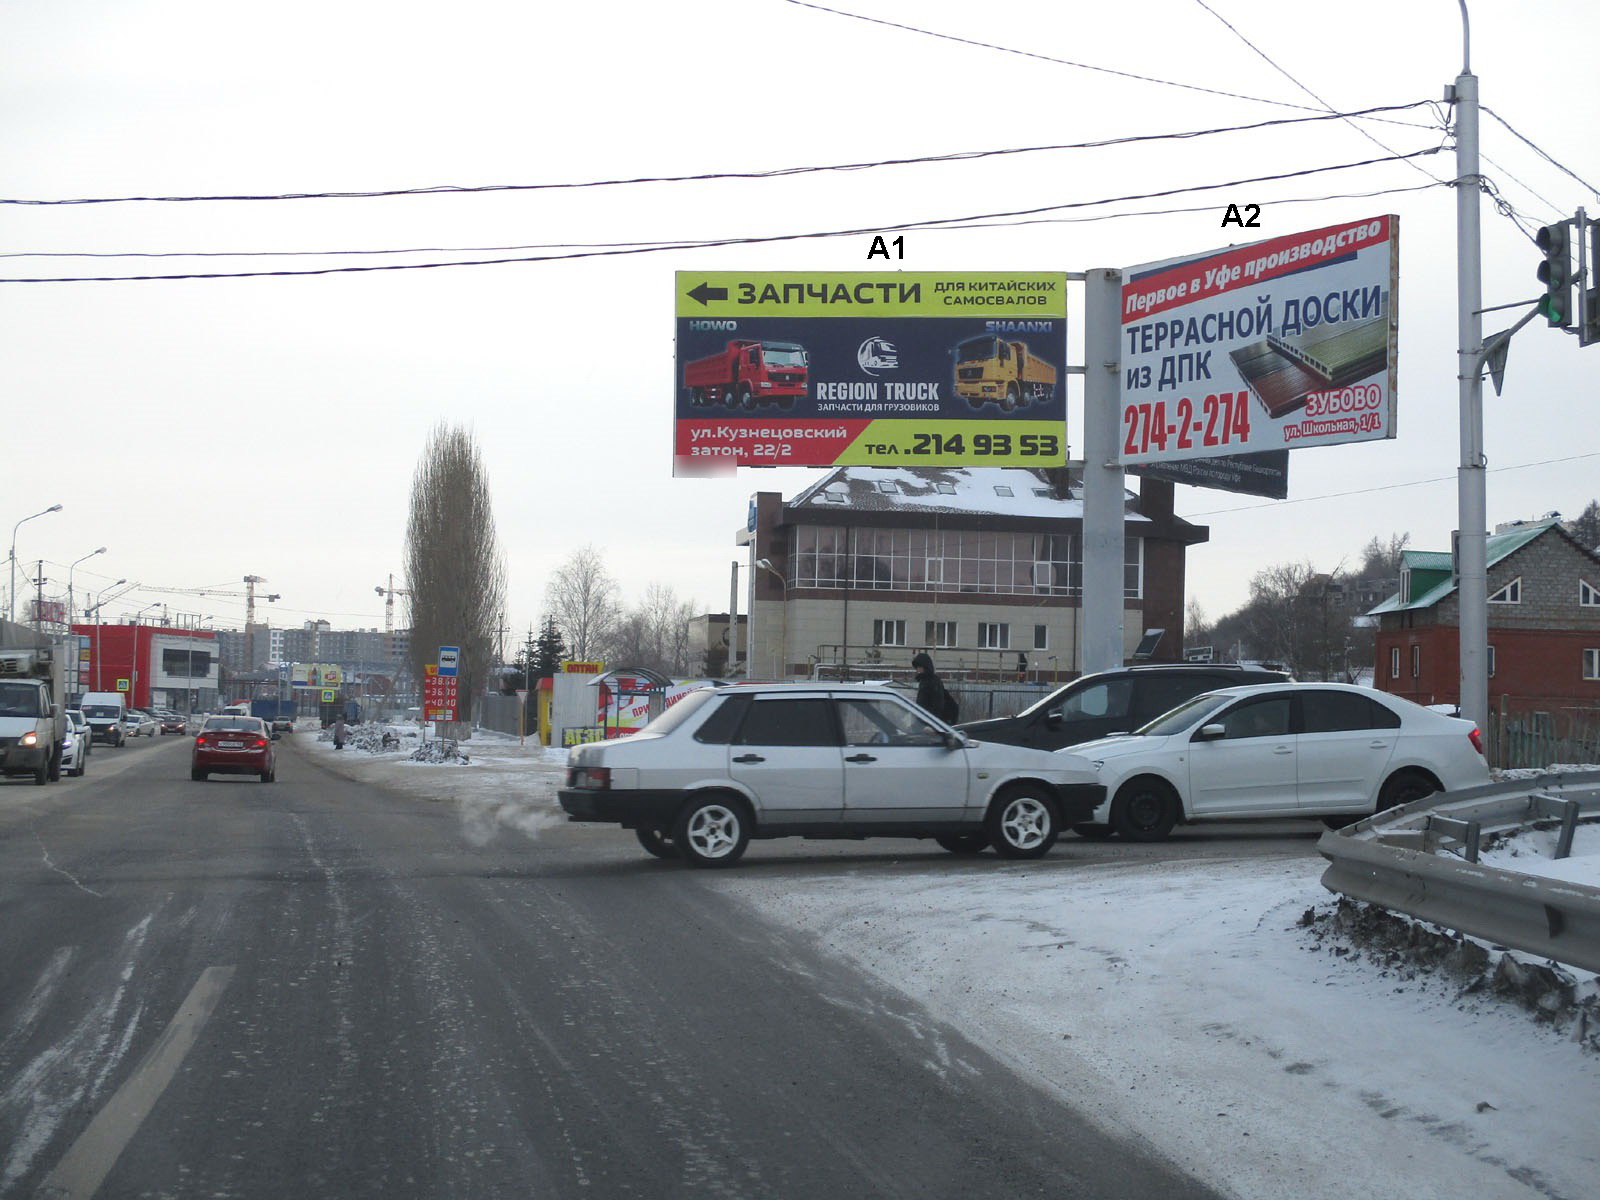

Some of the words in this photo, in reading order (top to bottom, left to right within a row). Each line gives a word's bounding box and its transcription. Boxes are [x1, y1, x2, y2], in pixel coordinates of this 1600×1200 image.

[1126, 282, 1187, 314] Первое
[1190, 278, 1201, 294] в
[1204, 264, 1241, 290] Уфе
[1244, 220, 1381, 279] производство
[738, 283, 921, 304] ЗАПЧАСТИ
[934, 282, 965, 293] ДЛЯ
[968, 280, 1056, 291] КИТАЙСКИХ
[943, 296, 1047, 306] САМОСВАЛОВ
[689, 320, 738, 331] HOWO
[985, 321, 1053, 332] SHAANXI
[1126, 295, 1273, 355] ТЕРРАСНОЙ
[1281, 285, 1382, 337] ДОСКИ
[1126, 365, 1151, 390] из
[1158, 350, 1212, 391] ДПК
[816, 382, 878, 400] REGION
[884, 382, 940, 400] TRUCK
[1305, 384, 1382, 416] ЗУБОВО
[817, 403, 863, 411] ЗАПЧАСТИ
[864, 403, 882, 412] ДЛЯ
[884, 403, 940, 411] ГРУЗОВИКОВ
[1124, 390, 1250, 455] 274-2-274
[1284, 425, 1300, 441] ул.
[1302, 418, 1359, 435] Школьная,
[1360, 414, 1381, 432] 1/1
[691, 444, 749, 457] затон,
[753, 443, 792, 459] 22/2
[974, 434, 1012, 456] 93
[1020, 434, 1059, 456] 53
